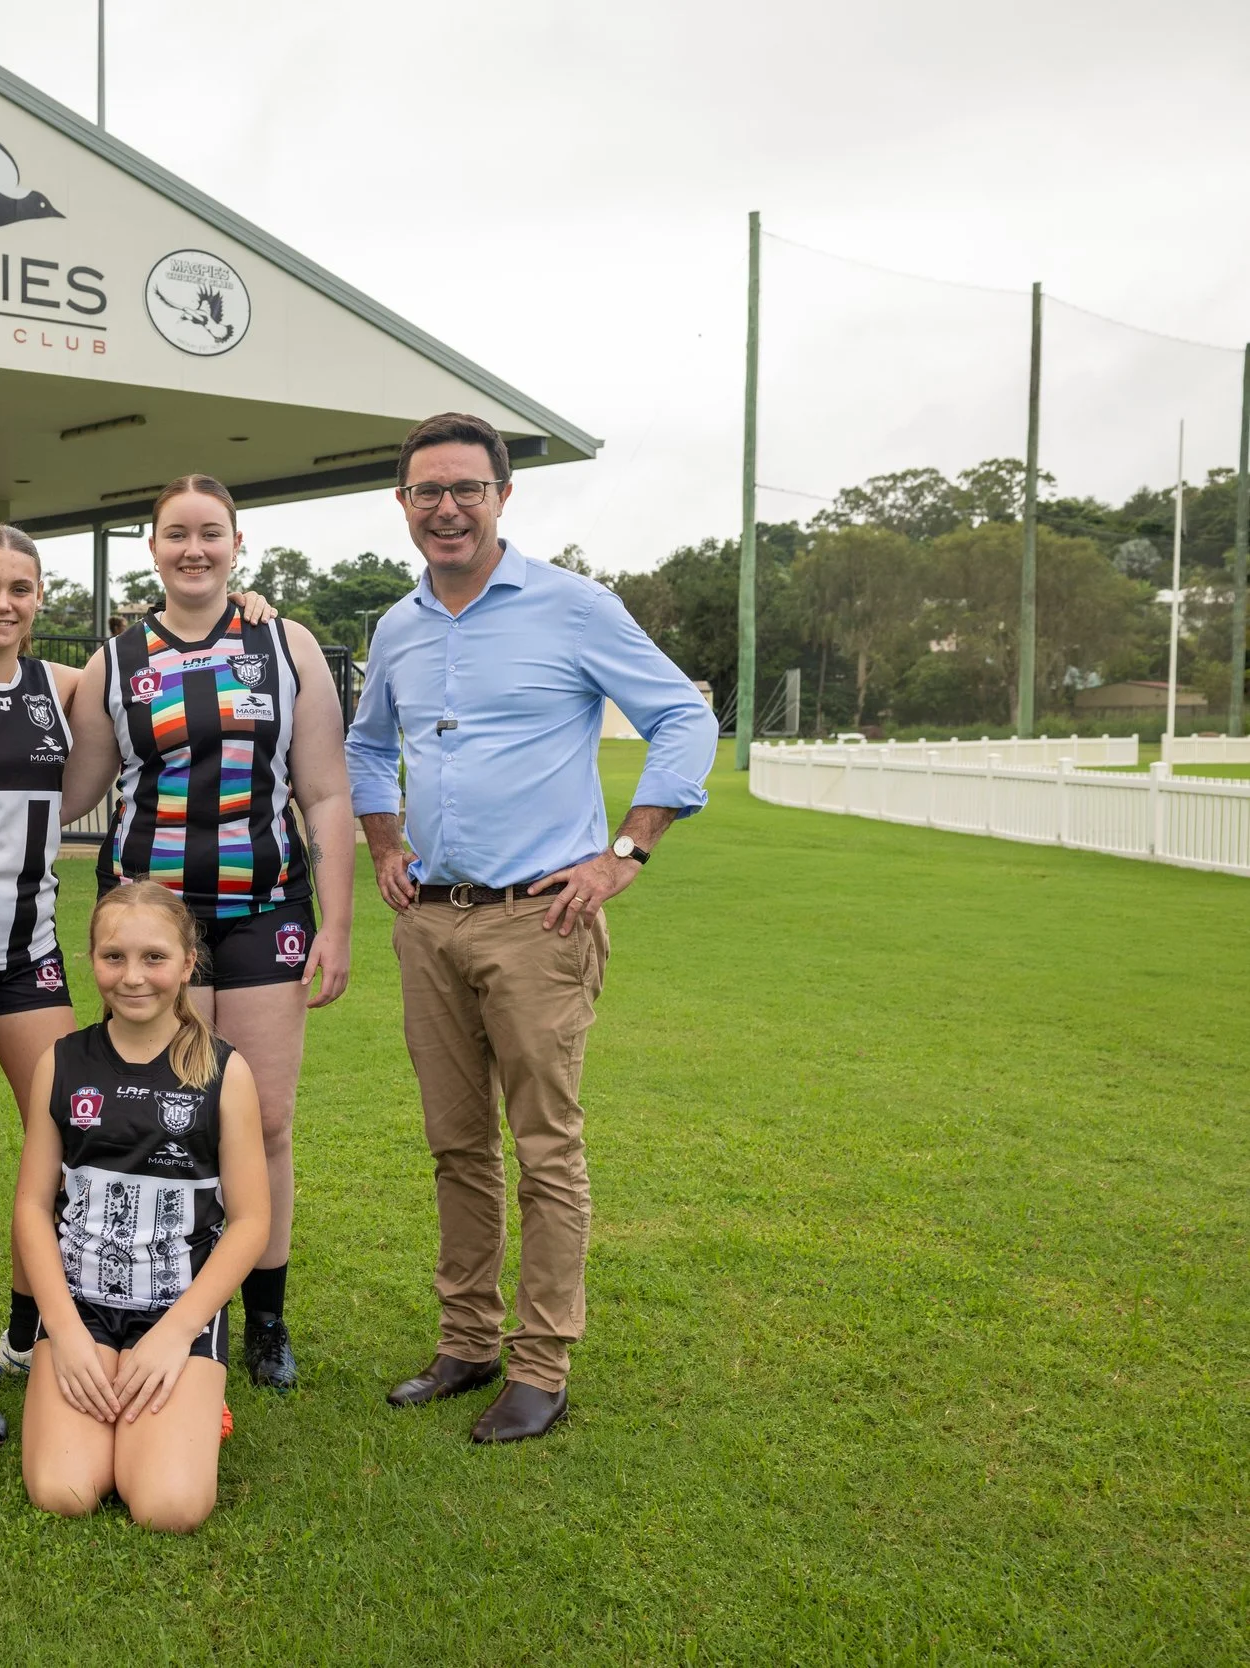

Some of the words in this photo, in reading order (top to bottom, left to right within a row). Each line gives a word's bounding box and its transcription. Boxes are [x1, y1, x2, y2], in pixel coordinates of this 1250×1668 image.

[170, 259, 230, 281] MAGPIES
[13, 328, 107, 356] CLUB
[182, 656, 212, 666] LRF
[240, 665, 258, 678] AFC
[138, 678, 155, 694] Q
[236, 708, 272, 716] MAGPIES
[284, 924, 300, 932] AFL
[284, 936, 300, 954] Q
[42, 966, 57, 980] Q
[116, 1086, 150, 1095] LRF
[166, 1092, 192, 1100] MAGPIES
[76, 1099, 94, 1117] Q
[168, 1106, 187, 1121] AFC
[148, 1157, 194, 1168] MAGPIES
